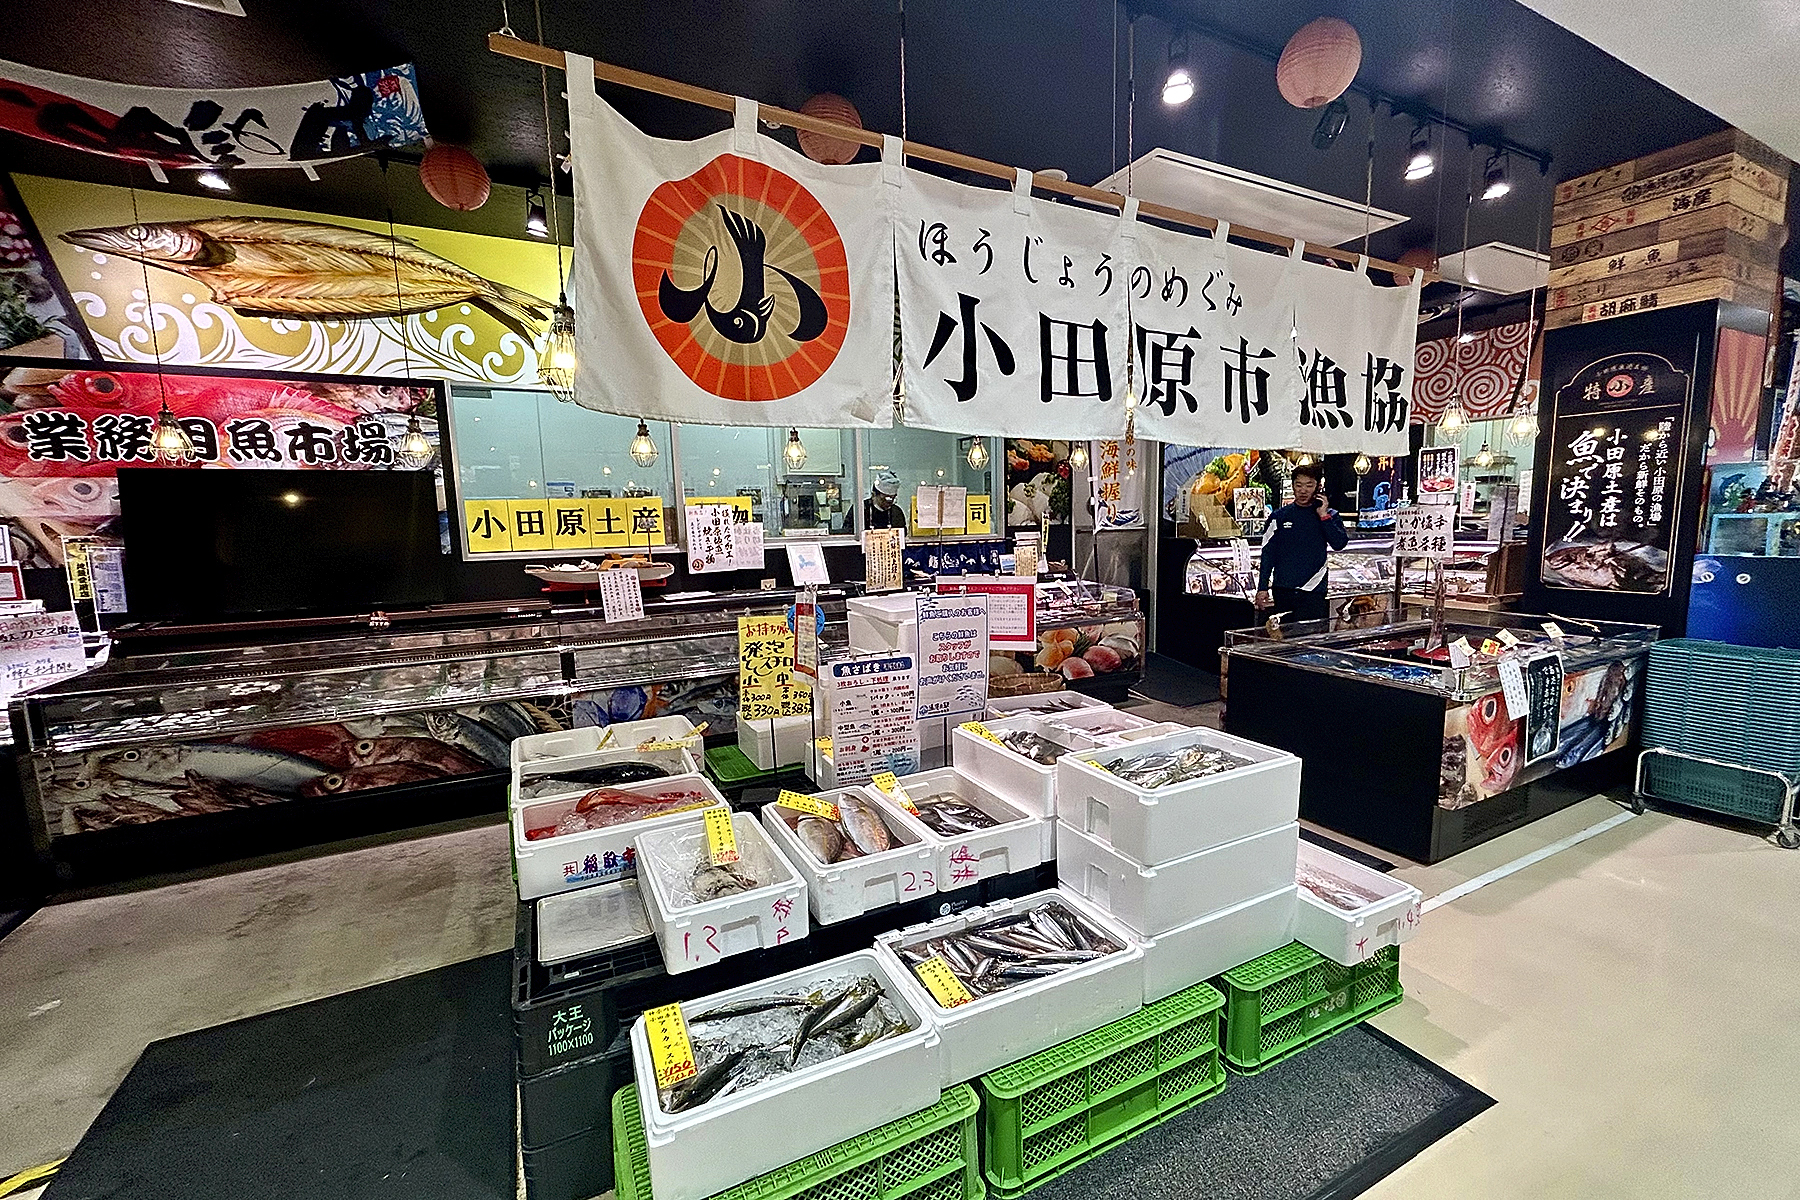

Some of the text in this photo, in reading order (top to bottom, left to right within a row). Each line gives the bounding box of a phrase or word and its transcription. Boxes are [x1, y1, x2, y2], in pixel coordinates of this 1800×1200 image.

[920, 217, 1244, 317] ほうじょうのめぐみ
[1607, 249, 1663, 274] 鮮魚
[1599, 293, 1659, 317] 胡麻鯖
[922, 292, 1411, 437] 小田原市漁協
[25, 411, 396, 466] 業務用魚市場
[1099, 440, 1122, 524] 海鮮握り
[1599, 428, 1629, 528] 小田原土産は
[471, 507, 662, 539] 小田原土産
[970, 503, 987, 525] 司
[938, 640, 972, 652] スタッフが
[743, 674, 760, 686] 小
[776, 671, 789, 685] 中
[840, 663, 880, 677] 魚さばき
[552, 1004, 584, 1027] 大王
[547, 1017, 592, 1043] パッケージ
[658, 1019, 674, 1060] アカカマス
